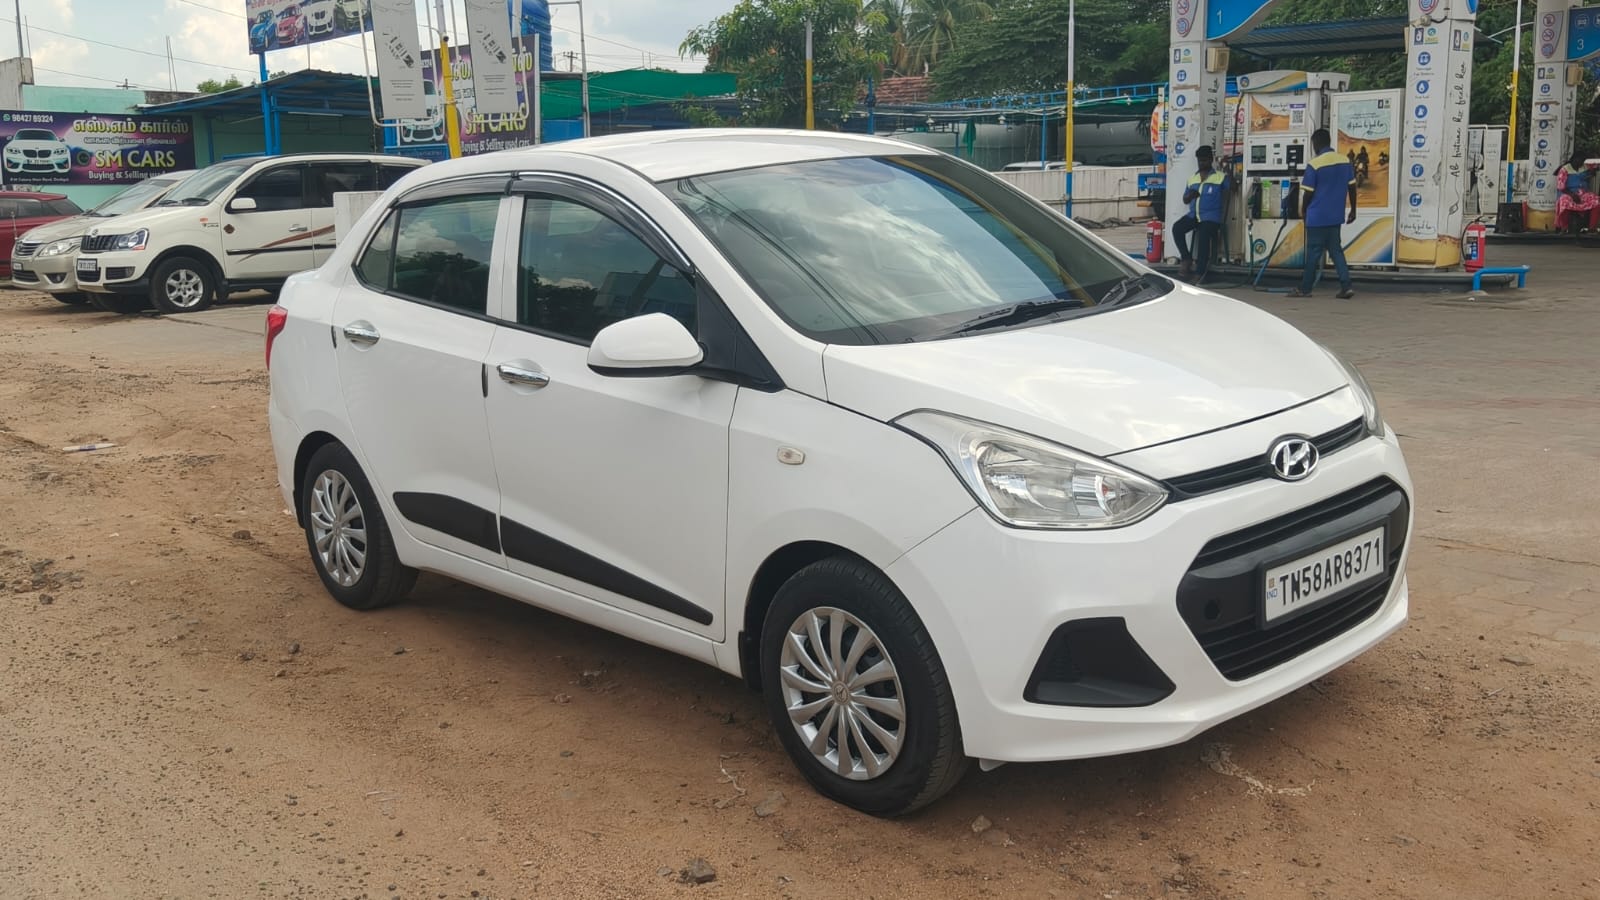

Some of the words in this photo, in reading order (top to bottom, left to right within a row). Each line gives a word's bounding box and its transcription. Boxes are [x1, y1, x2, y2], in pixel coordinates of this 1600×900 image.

[1216, 9, 1223, 25] 1
[1576, 38, 1585, 51] 3
[95, 151, 122, 167] SM
[128, 151, 175, 168] CARS
[88, 171, 115, 180] Buying
[116, 171, 123, 179] &
[124, 171, 148, 180] Selling
[1279, 537, 1381, 606] TN58AR8371
